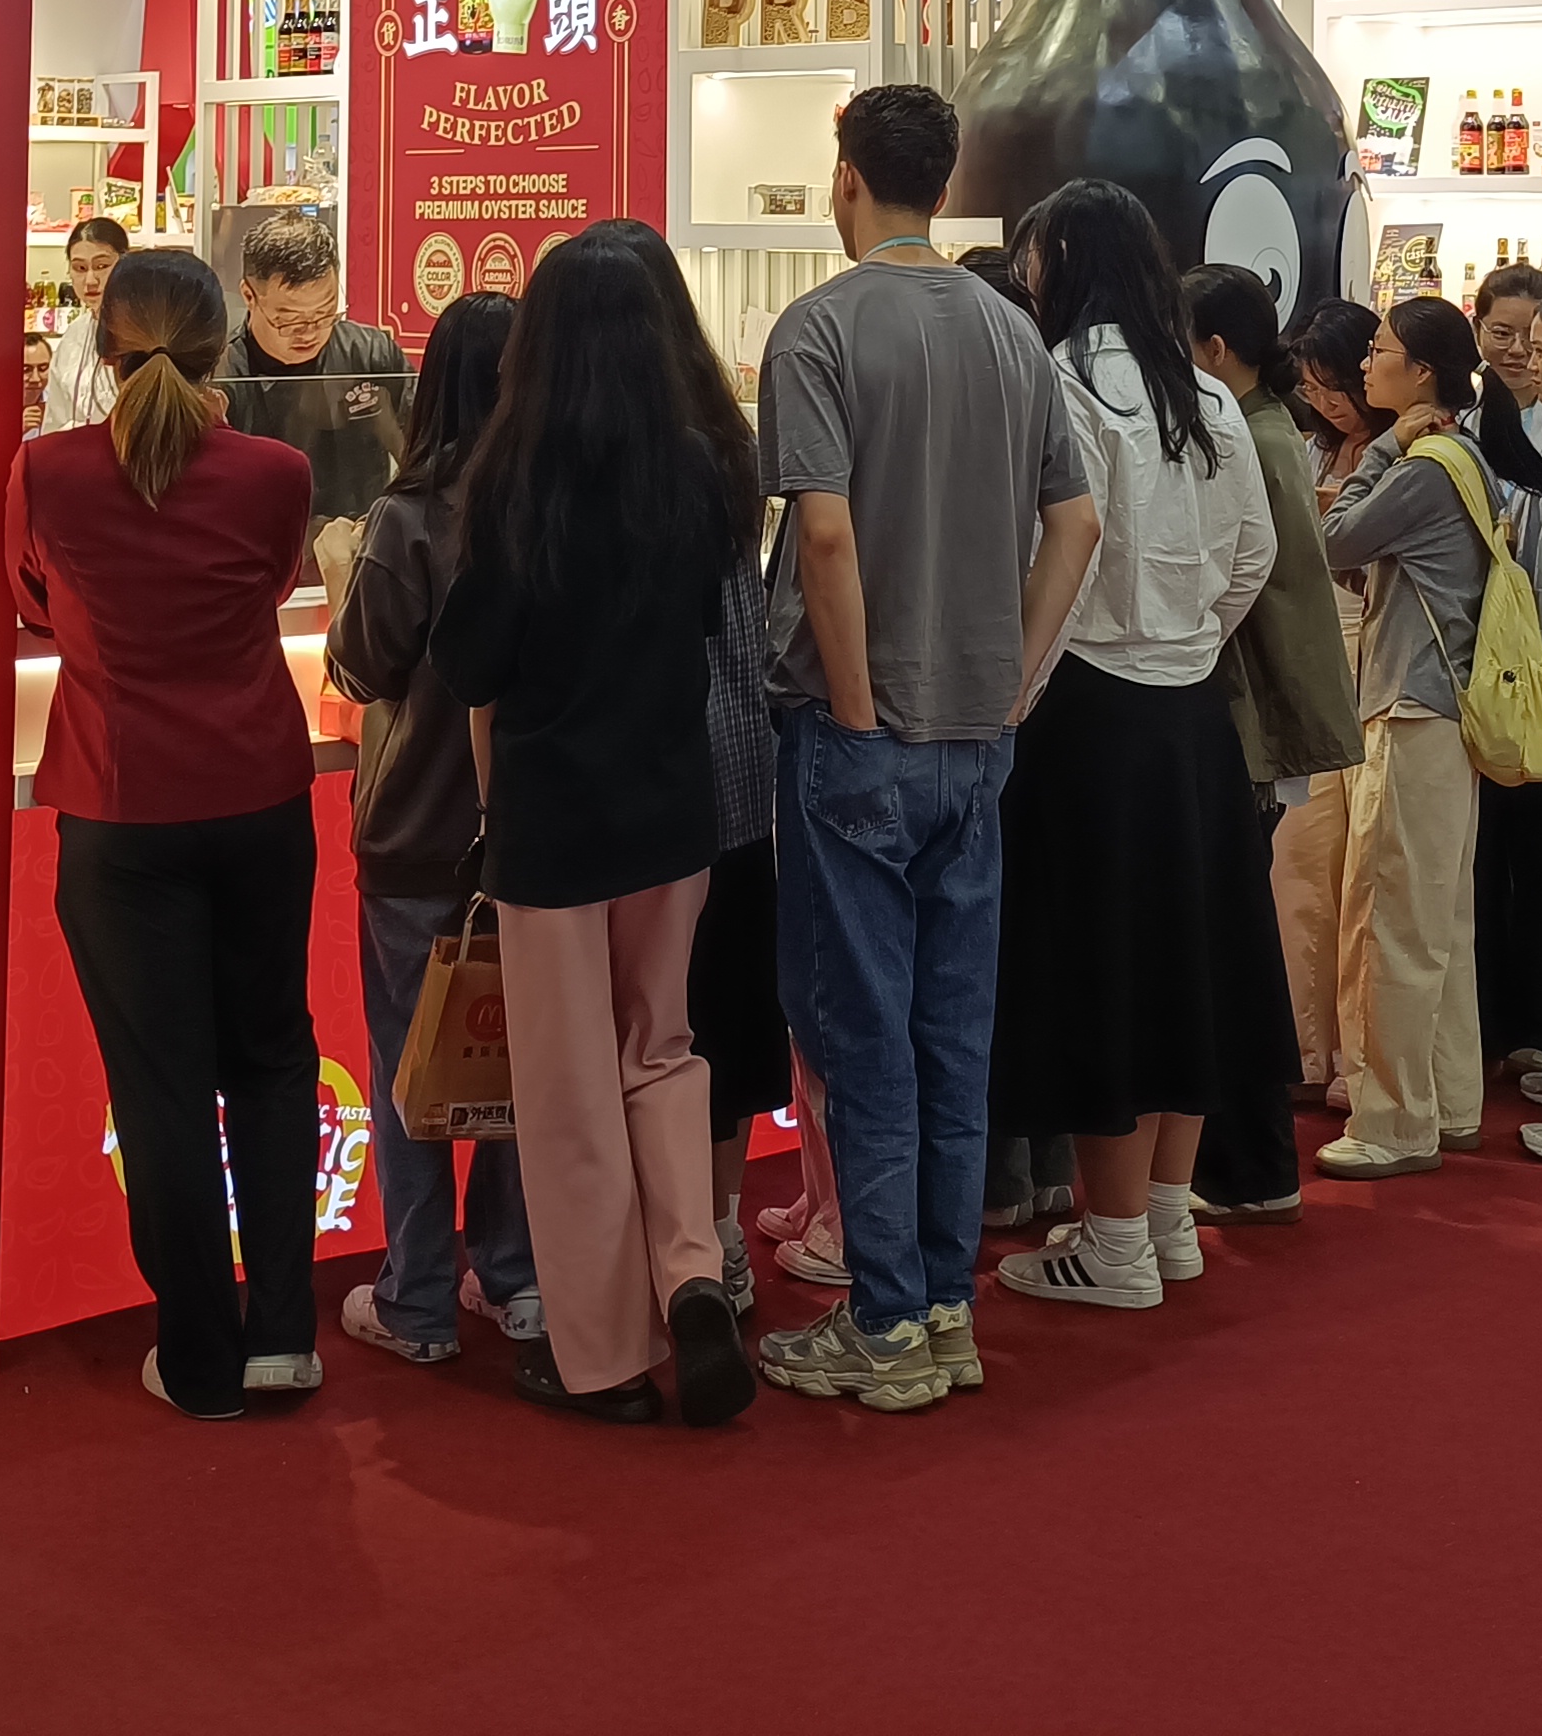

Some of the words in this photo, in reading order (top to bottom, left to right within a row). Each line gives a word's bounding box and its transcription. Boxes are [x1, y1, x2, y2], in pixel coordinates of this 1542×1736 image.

[452, 77, 550, 112] FLAVOR
[420, 100, 582, 146] PERFECTED
[429, 176, 439, 195] 3
[441, 176, 485, 195] STEPS
[487, 175, 507, 194] TO
[509, 173, 568, 194] CHOOSE
[414, 200, 480, 220] PREMIUM
[481, 199, 537, 219] OYSTER
[538, 198, 588, 219] SAUCE
[426, 271, 452, 282] COLOR
[484, 271, 512, 283] AROMA
